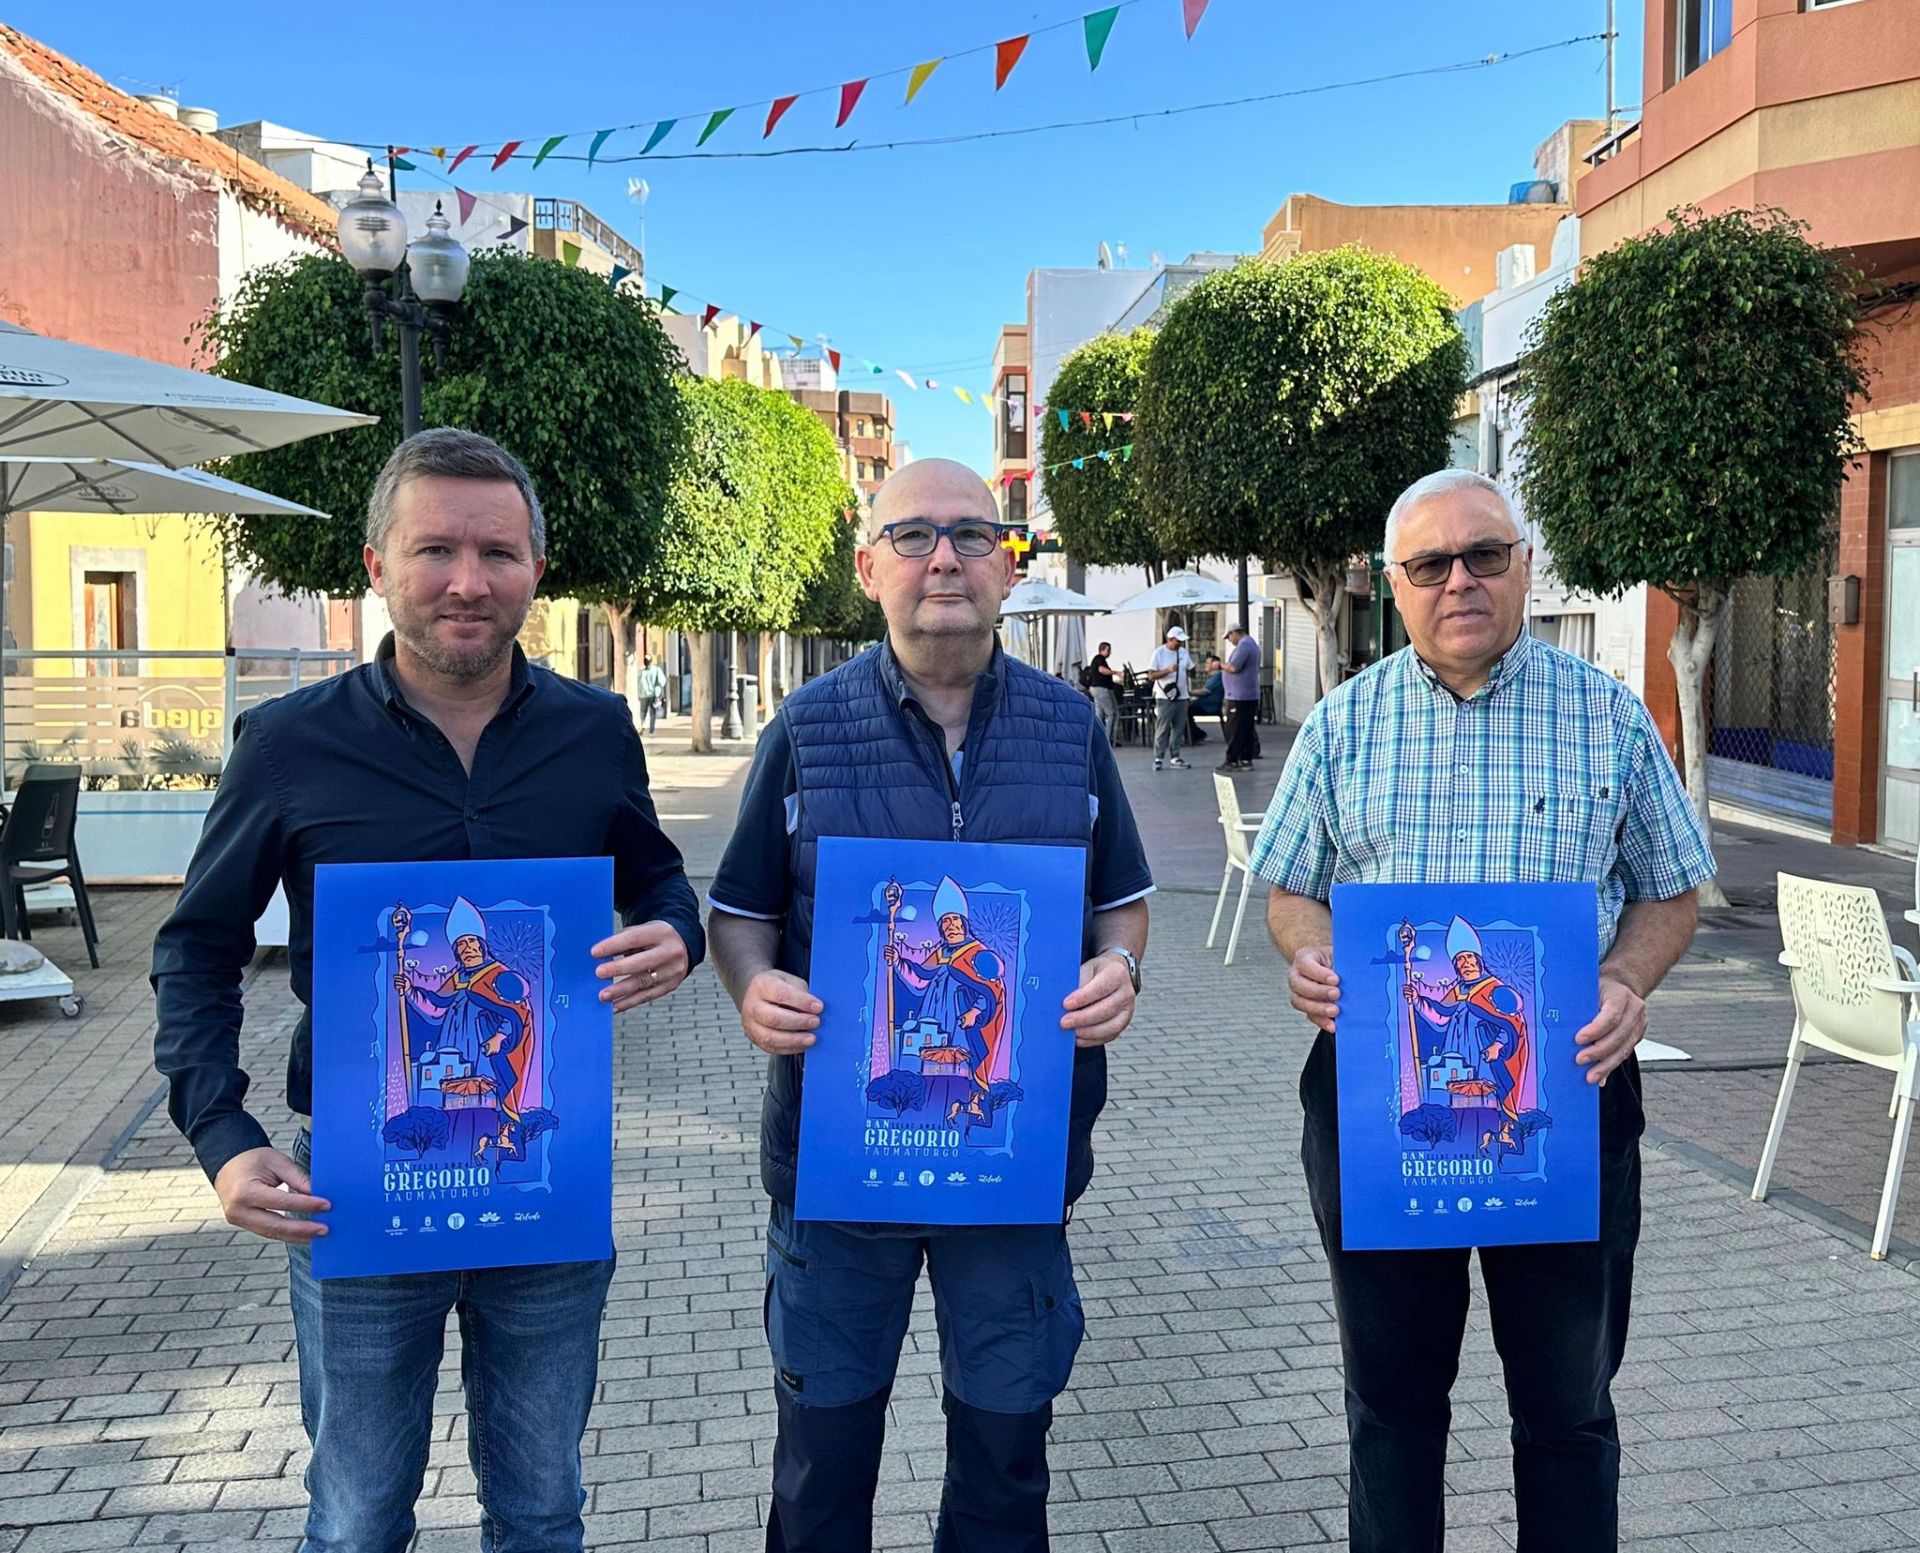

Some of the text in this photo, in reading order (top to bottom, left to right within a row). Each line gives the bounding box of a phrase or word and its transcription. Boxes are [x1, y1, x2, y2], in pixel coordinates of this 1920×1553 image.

[864, 1119, 890, 1129] SAN
[864, 1128, 960, 1148] GREGORIO
[864, 1146, 960, 1158] TAUMATURGO
[1401, 1151, 1425, 1160] SAN
[384, 1162, 411, 1173] SAN
[1401, 1159, 1494, 1177] GREGORIO
[383, 1167, 490, 1192] GREGORIO
[1402, 1175, 1494, 1187] TAUMATURGO
[384, 1186, 490, 1203] TAUMATURGO
